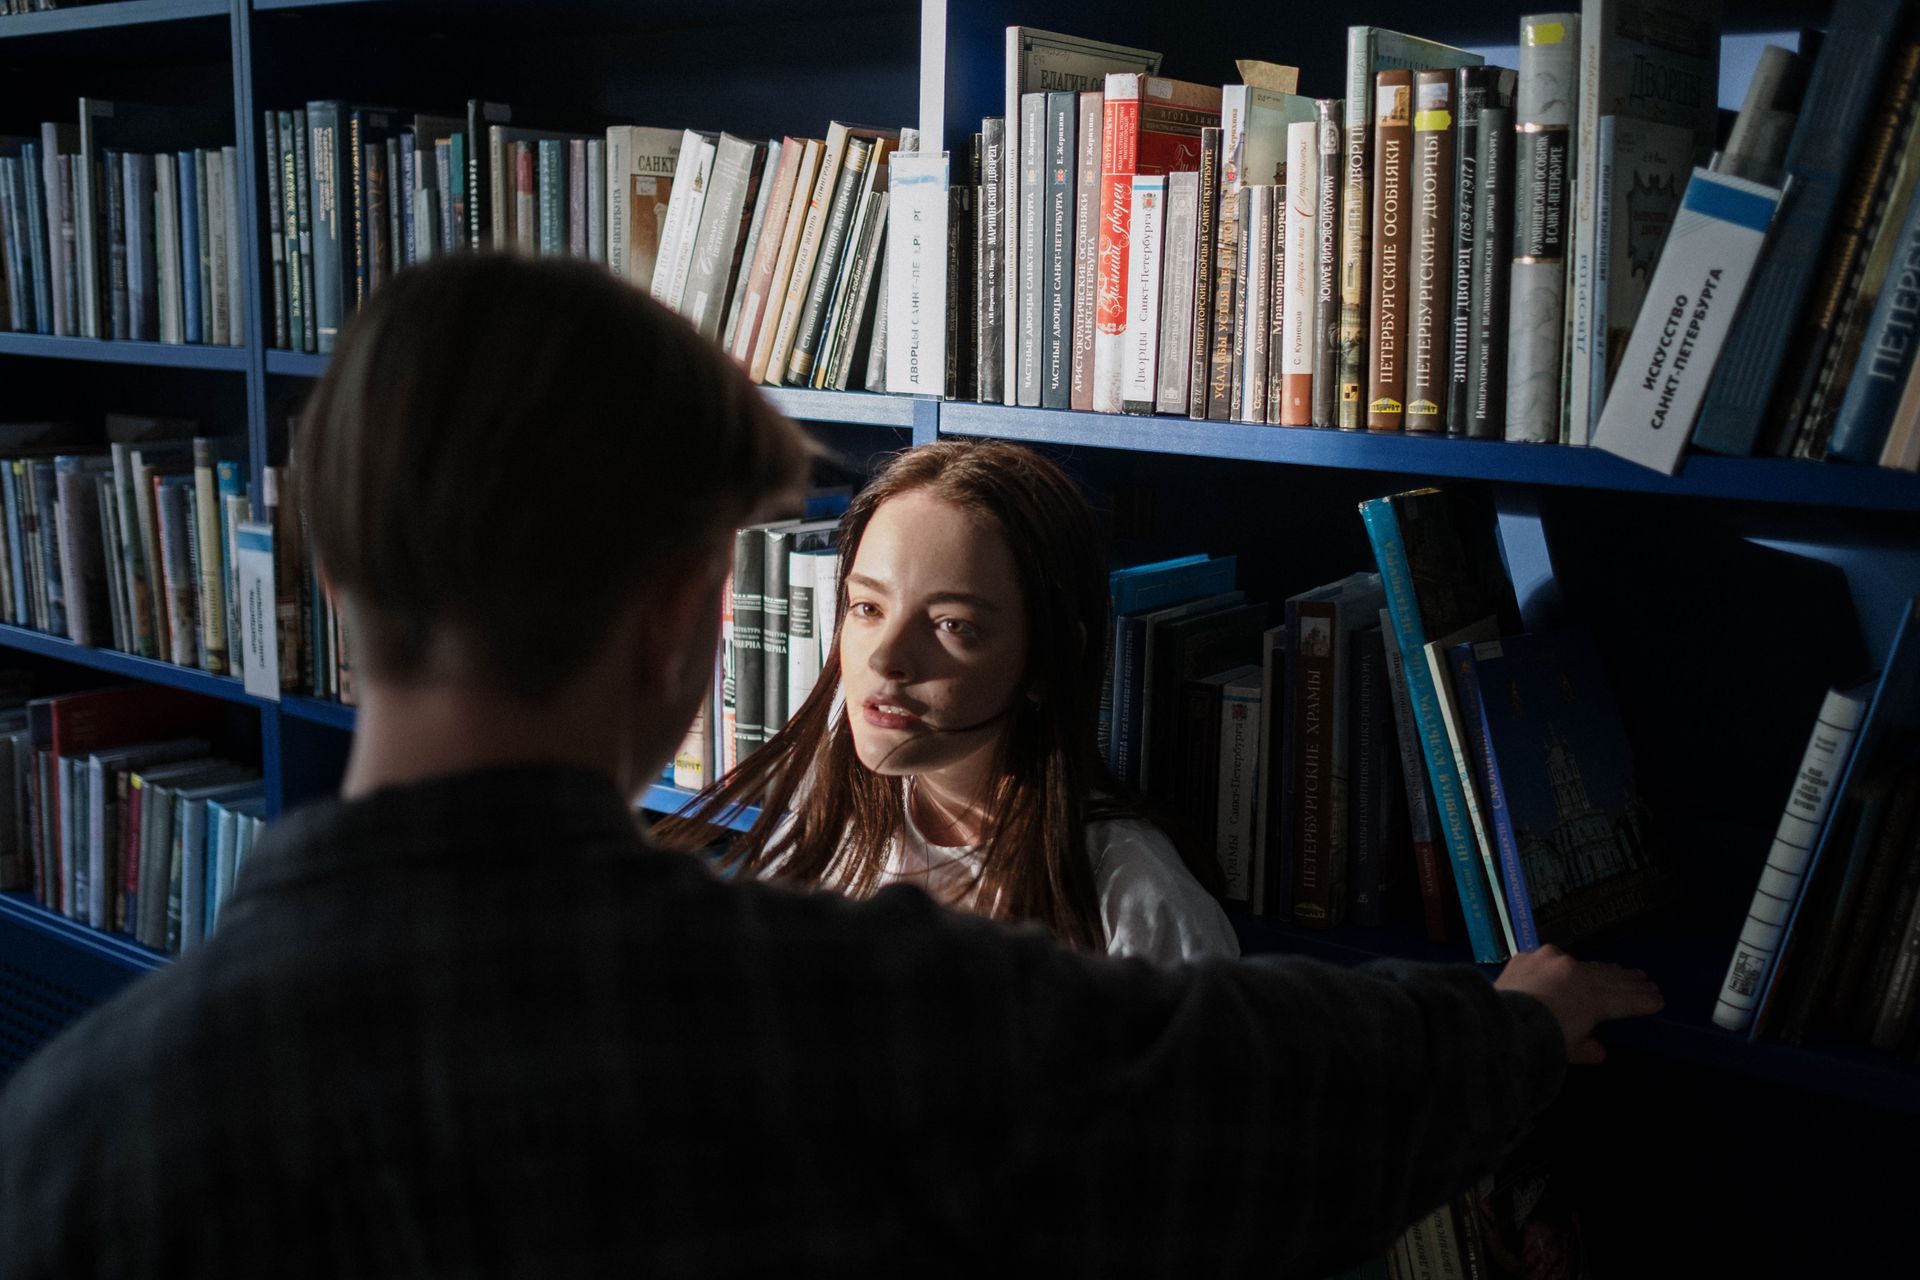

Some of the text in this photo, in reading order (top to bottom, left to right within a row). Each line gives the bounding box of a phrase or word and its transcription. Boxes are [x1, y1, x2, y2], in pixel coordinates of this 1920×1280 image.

[986, 144, 999, 181] ДВОРЕЦ
[1107, 181, 1128, 234] дворец
[1202, 149, 1212, 233] САНКТ-ПЕТЕРБУРГЕ
[1421, 136, 1439, 219] ДВОРЦЫ
[1529, 135, 1549, 255] РУМЯНЦЕВСКИЙ ОСОБНЯК
[1547, 145, 1562, 235] САНКТ-ПЕТЕРБУРГЕ
[986, 183, 998, 245] МАРИИНСКИЙ
[1321, 175, 1334, 302] МИХАЙЛОВСКИЙ ЗАМОК
[1024, 191, 1036, 389] ЧАСТНЫЕ ДВОРЦЫ САНКТ-ПЕТЕРБУРГА
[1051, 191, 1063, 390] ЧАСТНЫЕ ДВОРЦЫ САНКТ-ПЕТЕРБУРГА
[1074, 193, 1089, 393] АРИСТОКРАТИЧЕСКИЕ ОСОБНЯКИ
[1084, 236, 1095, 352] САНКТ-ПЕТЕРБУРГА
[1135, 212, 1154, 391] Дворцы Санкт-Петербурга
[1199, 244, 1209, 280] ДВОРЦЫ
[1220, 249, 1232, 286] РЕКИ
[1255, 215, 1268, 355] Дворец великого князя
[1272, 201, 1286, 336] Мраморный дворец
[1379, 139, 1399, 384] ПЕТЕРБУРГСКИЕ ОСОБНЯКИ
[1456, 247, 1472, 312] ДВОРЕЦ
[1197, 283, 1207, 356] ИМПЕРАТОРСКИЕ
[1219, 289, 1231, 333] УСТЬЯ
[1235, 313, 1244, 357] Особняк
[1294, 310, 1303, 354] Кузнецов
[1415, 227, 1435, 388] ПЕТЕРБУРГСКИЕ
[1452, 316, 1469, 384] ЗИМНИЙ
[1642, 294, 1688, 391] ИСКУССТВО
[1650, 269, 1723, 430] САНКТ-ПЕТЕРБУРГА
[909, 329, 920, 385] ДВОРЦЫ
[1213, 336, 1228, 400] УСАДЬБЫ
[1229, 720, 1244, 825] Санкт-Петербурга
[1302, 669, 1321, 889] ПЕТЕРБУРГСКИЕ ХРАМЫ
[1438, 773, 1470, 863] ЦЕРКОВНАЯ
